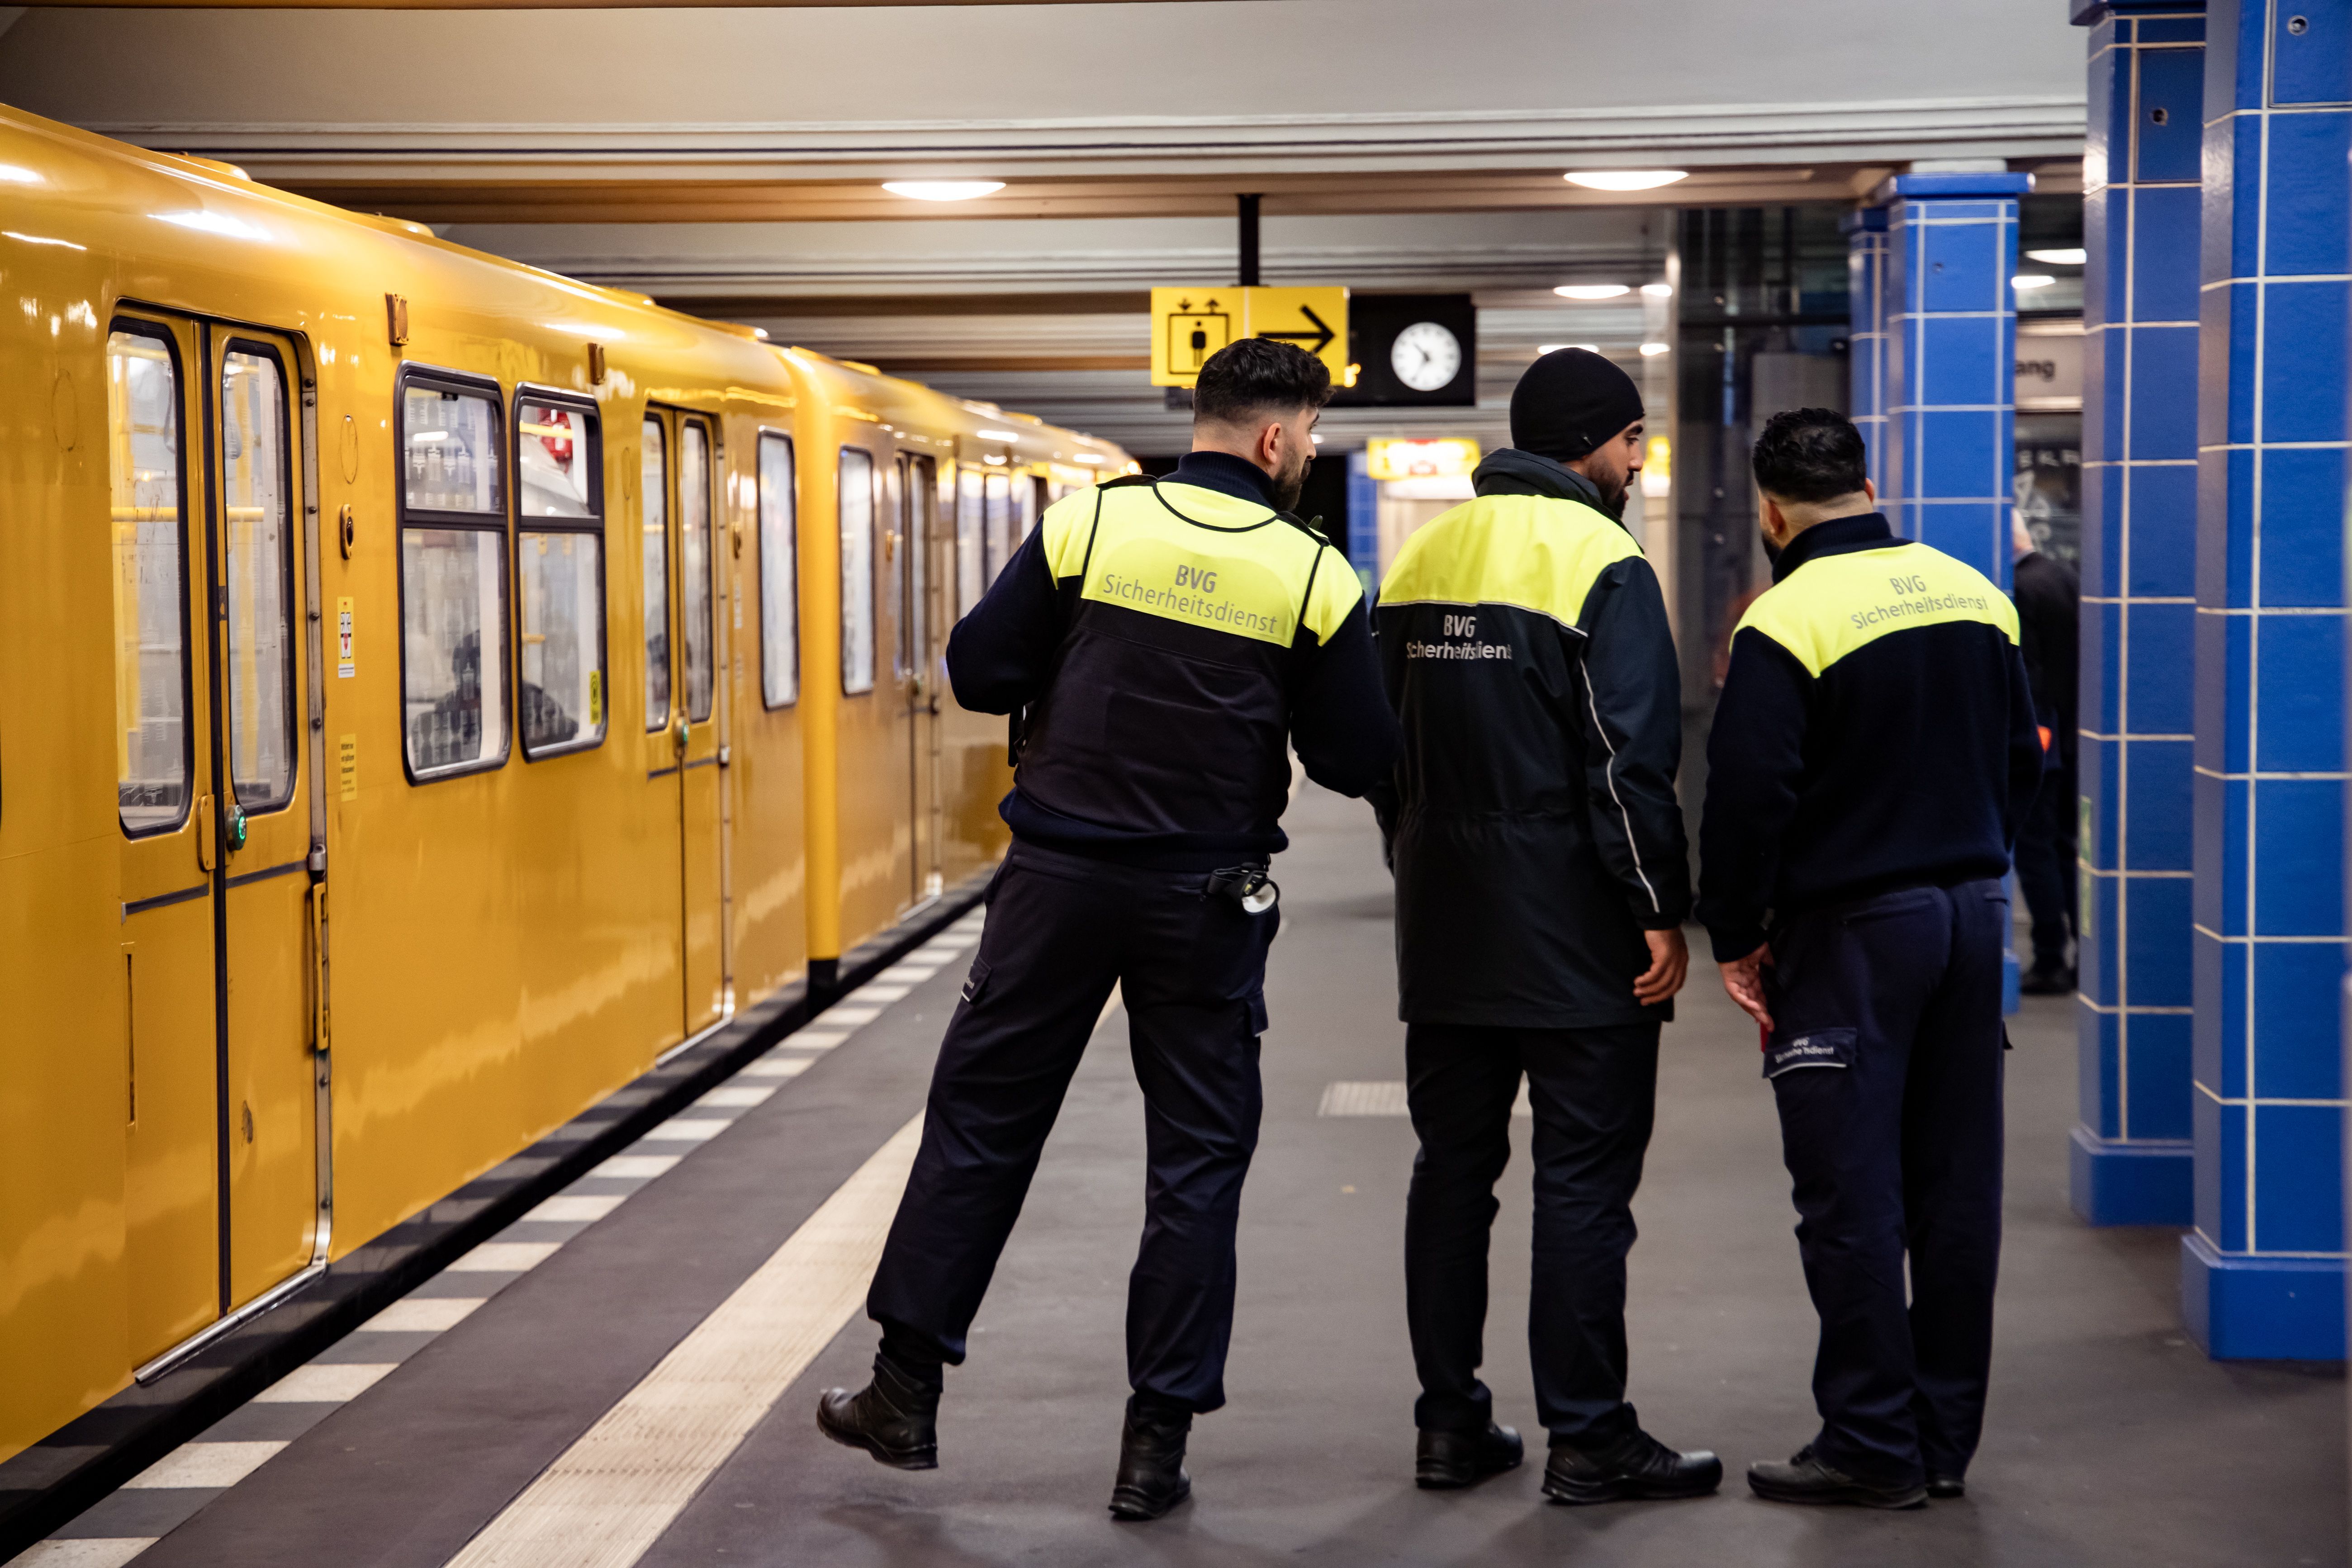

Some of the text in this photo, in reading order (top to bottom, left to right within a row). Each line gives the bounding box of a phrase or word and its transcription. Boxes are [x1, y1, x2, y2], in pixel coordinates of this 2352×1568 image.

[1175, 564, 1217, 593] BVG
[1889, 575, 1927, 595] BVG
[1103, 574, 1277, 634] Sicherheitsdienst
[1850, 593, 1989, 630] Sicherheitsdienst
[1443, 615, 1477, 638] BVG
